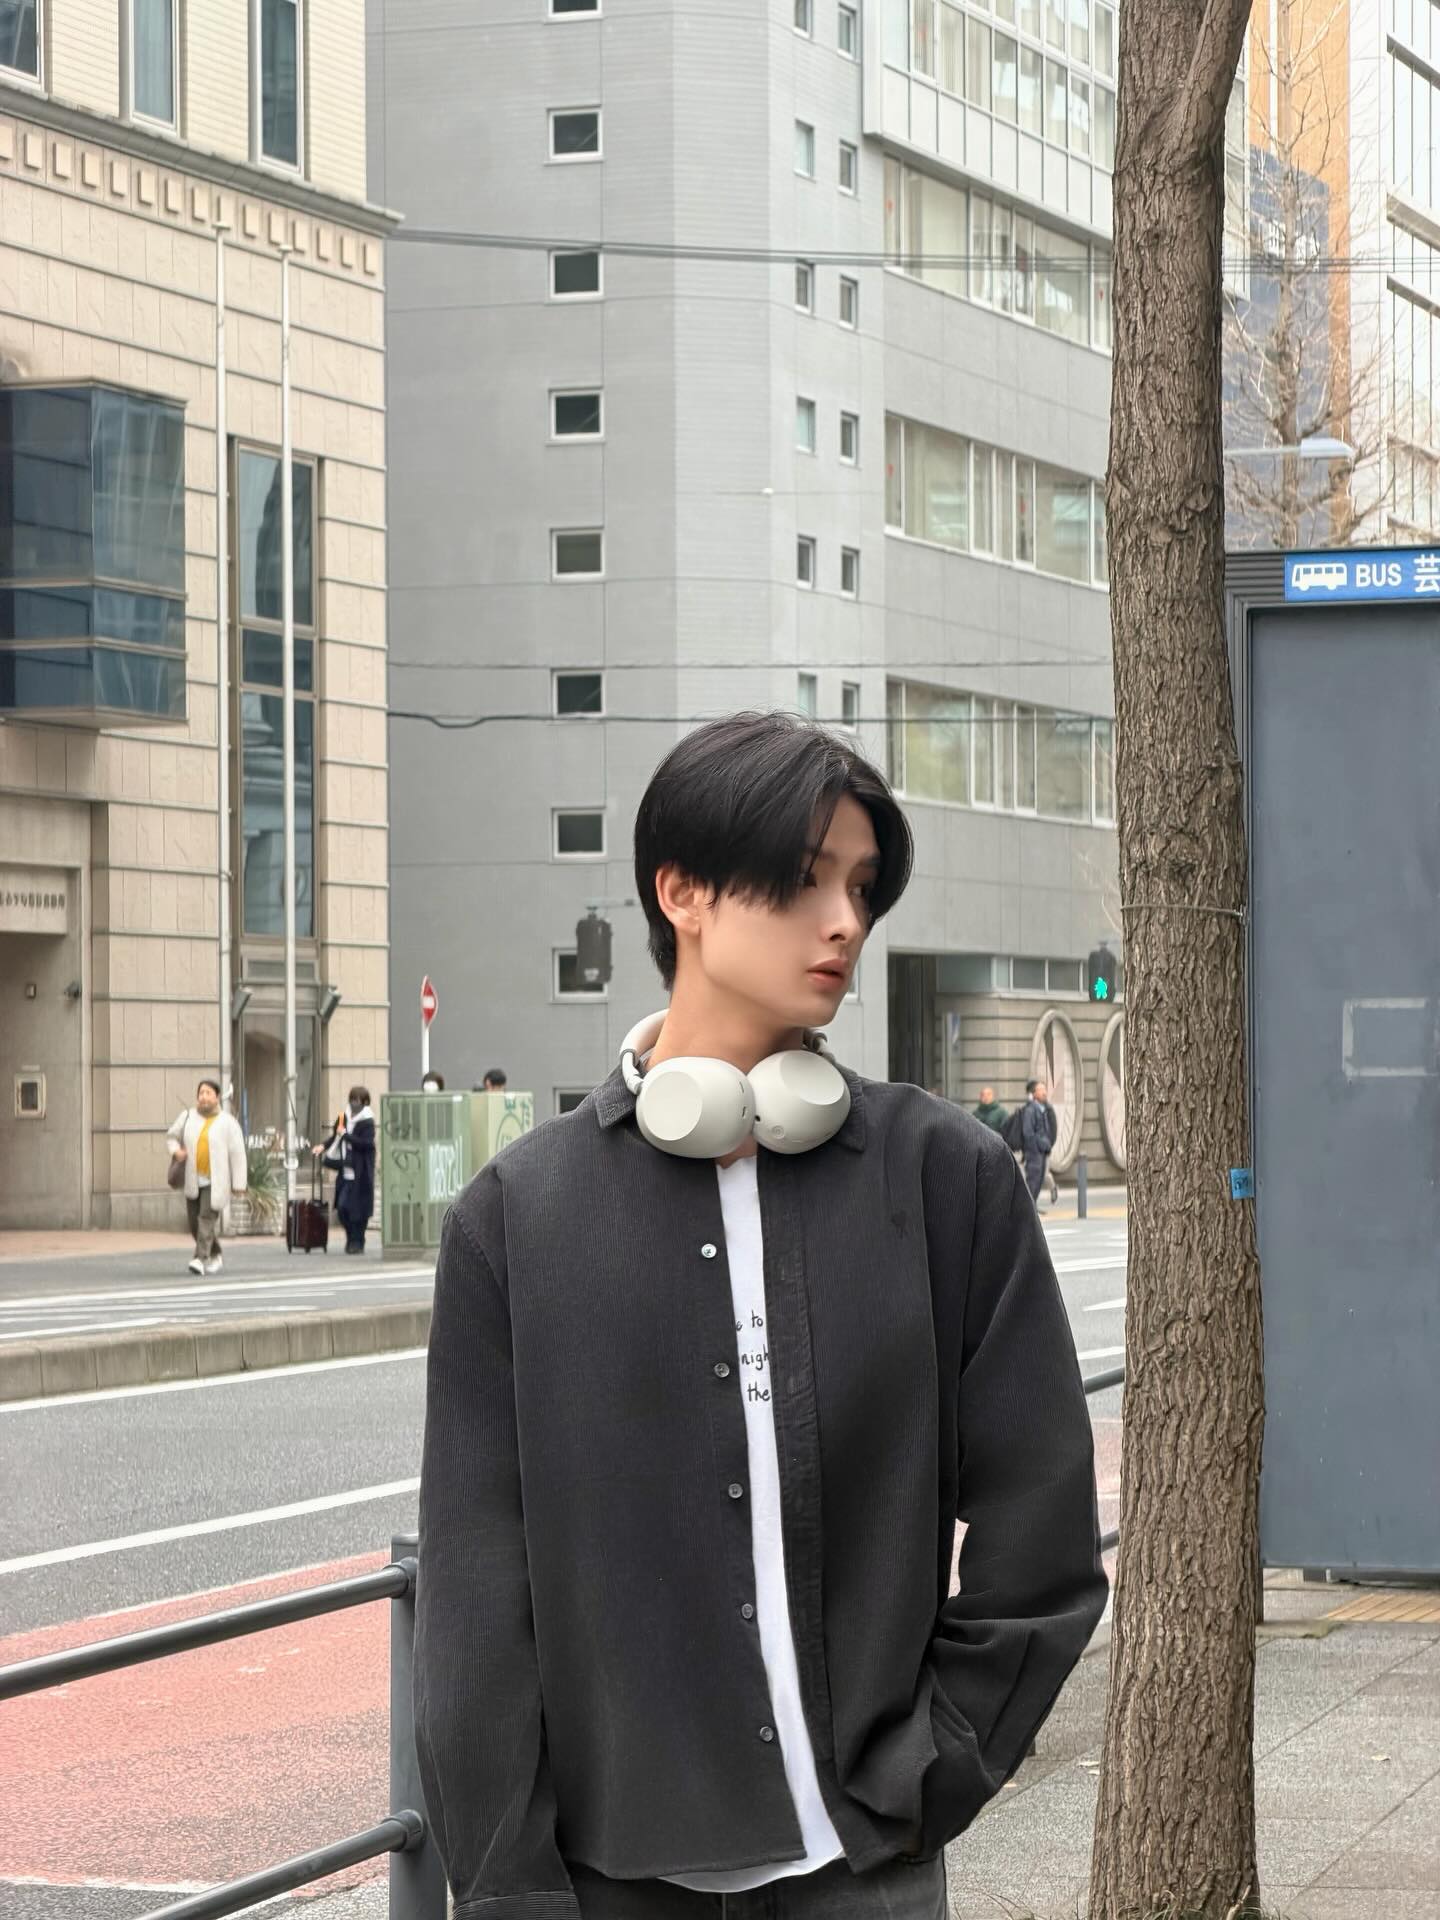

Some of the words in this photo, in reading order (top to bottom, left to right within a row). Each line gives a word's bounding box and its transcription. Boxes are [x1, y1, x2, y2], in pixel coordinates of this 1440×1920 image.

[1355, 563, 1402, 588] BUS
[751, 1309, 764, 1328] to
[747, 1381, 771, 1402] the
